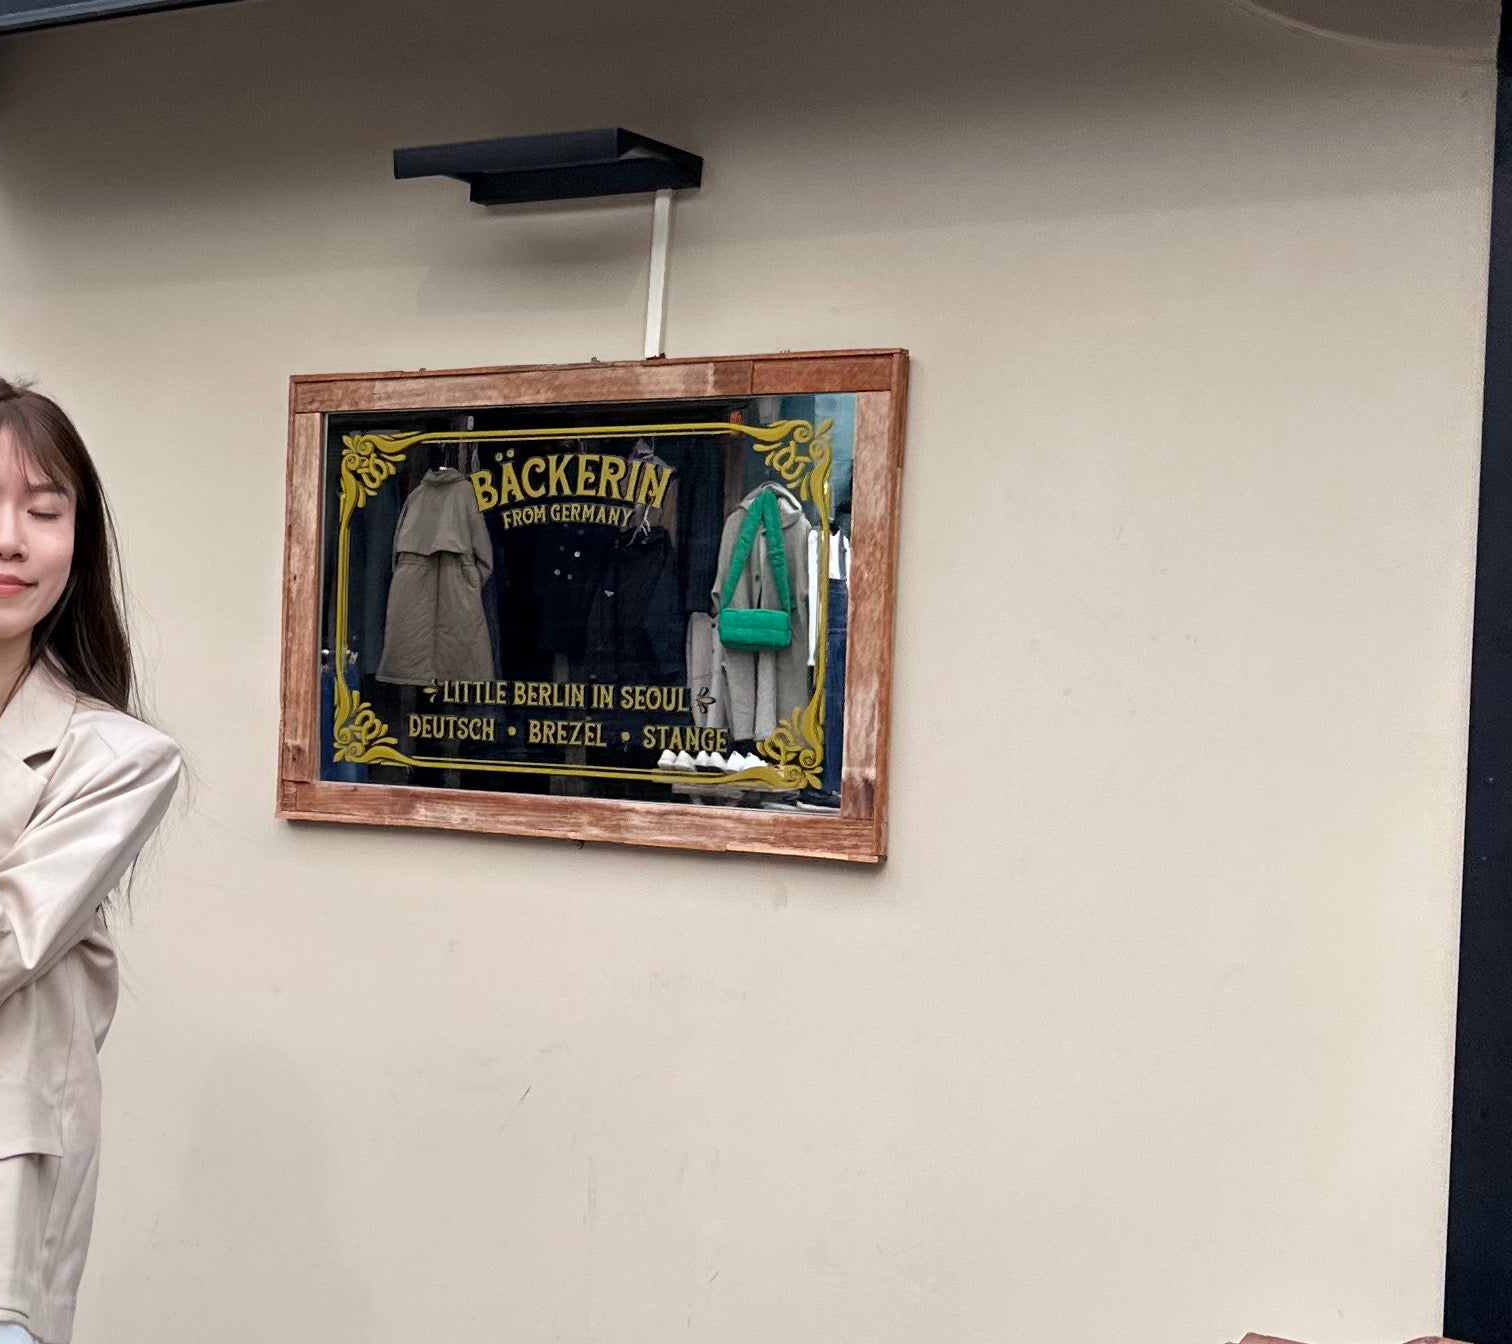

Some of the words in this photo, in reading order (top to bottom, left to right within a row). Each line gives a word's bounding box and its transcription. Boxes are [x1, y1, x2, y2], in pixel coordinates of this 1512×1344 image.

[470, 448, 673, 512] BÄCKERIN
[502, 504, 546, 529] FROM
[550, 503, 635, 528] GERMANY
[443, 680, 506, 704] LITTLE
[513, 681, 585, 708] BERLIN
[591, 684, 614, 709] IN
[620, 685, 689, 712] SEOUL
[408, 715, 495, 741] DEUTSCH
[528, 719, 607, 748] BREZEL
[642, 725, 730, 752] STANGE
